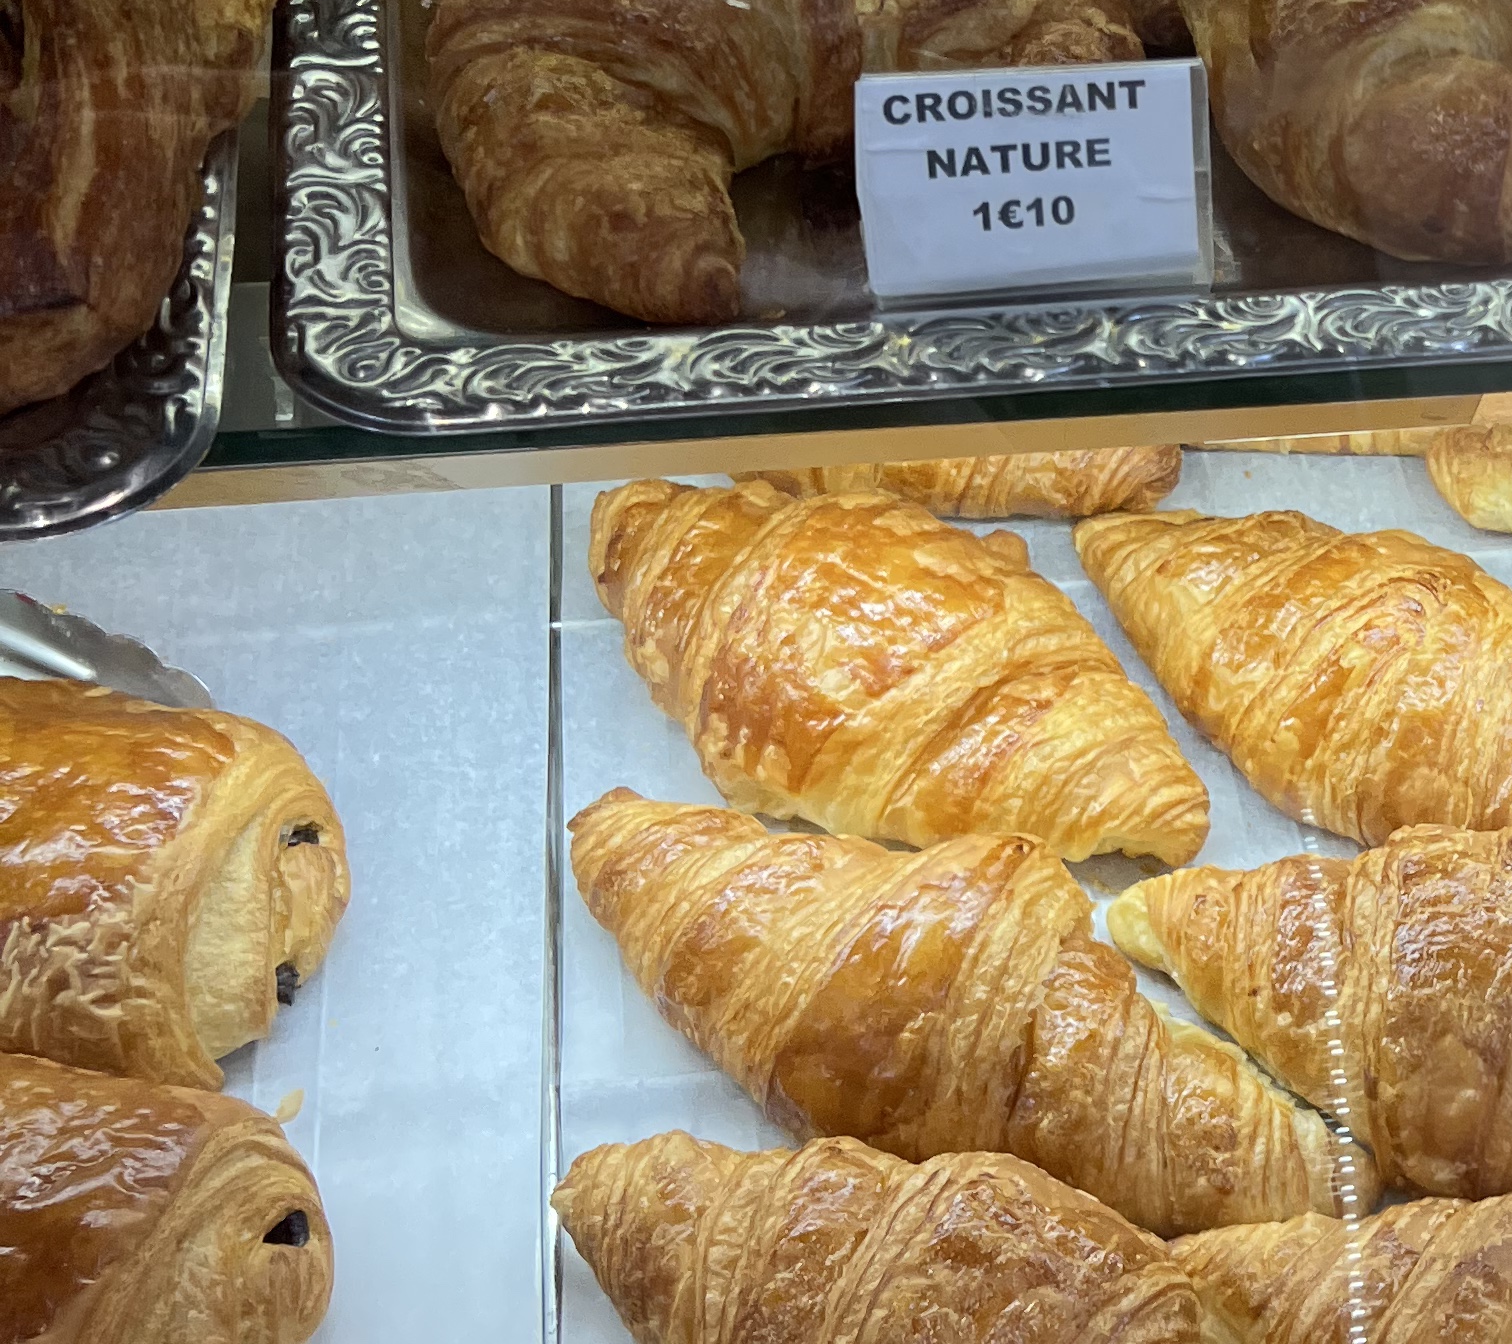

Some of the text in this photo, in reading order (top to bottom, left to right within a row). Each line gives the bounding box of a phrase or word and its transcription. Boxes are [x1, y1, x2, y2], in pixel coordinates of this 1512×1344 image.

[882, 79, 1146, 125] CROISSANT
[926, 138, 1112, 179] NATURE
[972, 195, 1075, 231] 1€10
